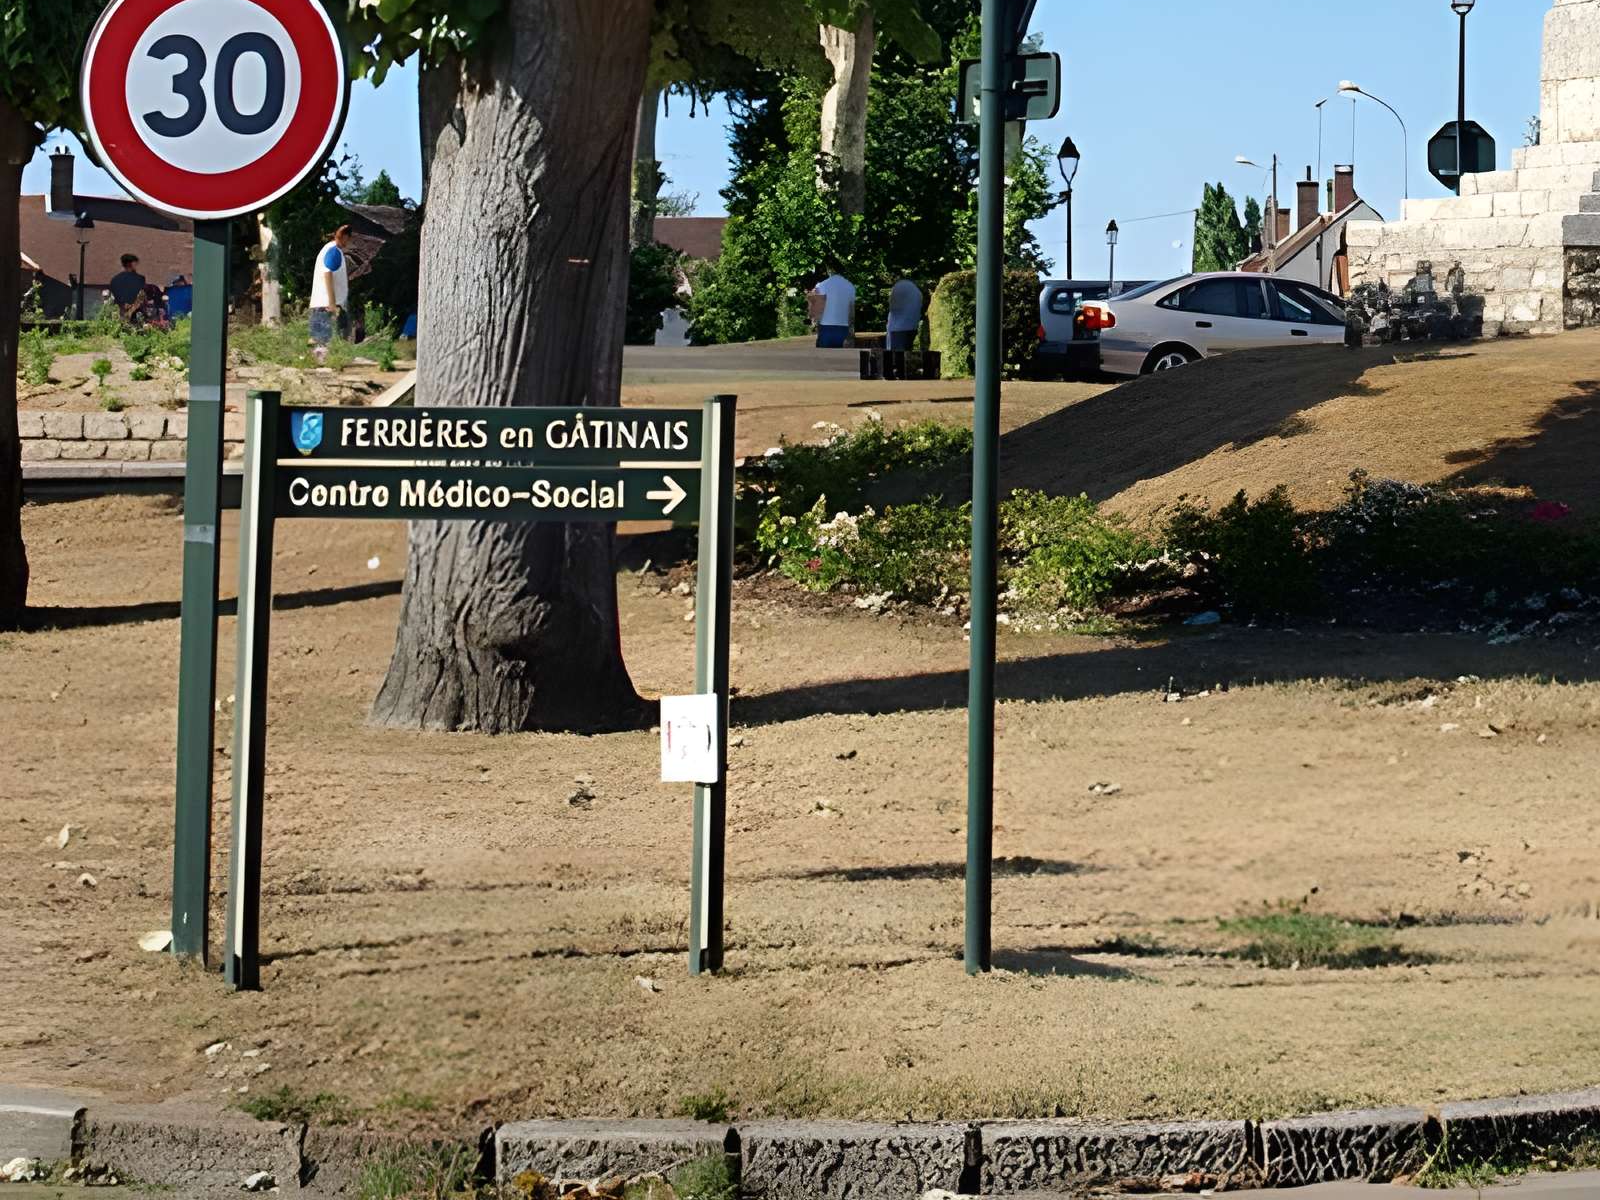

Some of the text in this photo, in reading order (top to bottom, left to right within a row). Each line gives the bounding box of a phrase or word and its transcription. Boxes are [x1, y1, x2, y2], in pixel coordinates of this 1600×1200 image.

[143, 32, 286, 138] 30
[341, 411, 488, 448] FERRIÈRES
[500, 427, 534, 448] en
